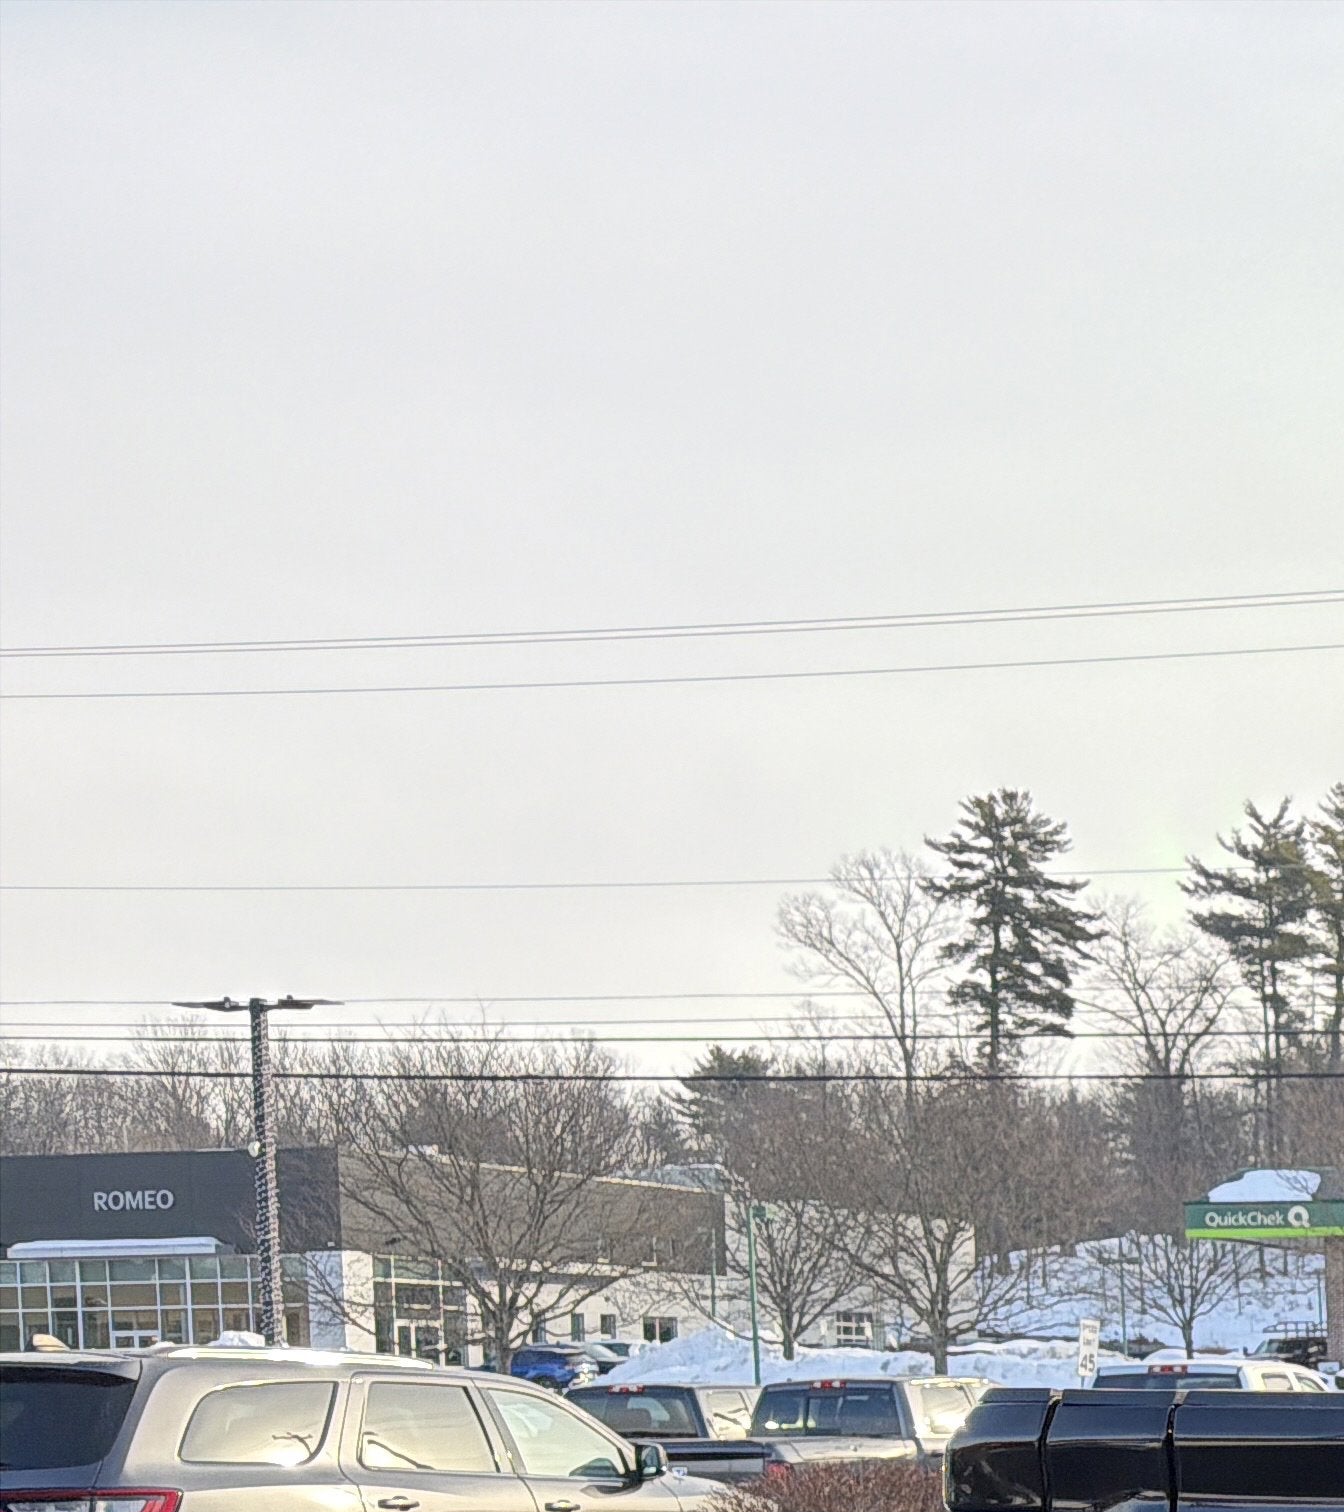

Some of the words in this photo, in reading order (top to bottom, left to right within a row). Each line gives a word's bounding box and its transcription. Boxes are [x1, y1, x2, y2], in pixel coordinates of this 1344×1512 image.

[93, 1189, 174, 1211] ROMEO
[1204, 1210, 1285, 1228] QuickChek
[1080, 1353, 1095, 1372] 45
